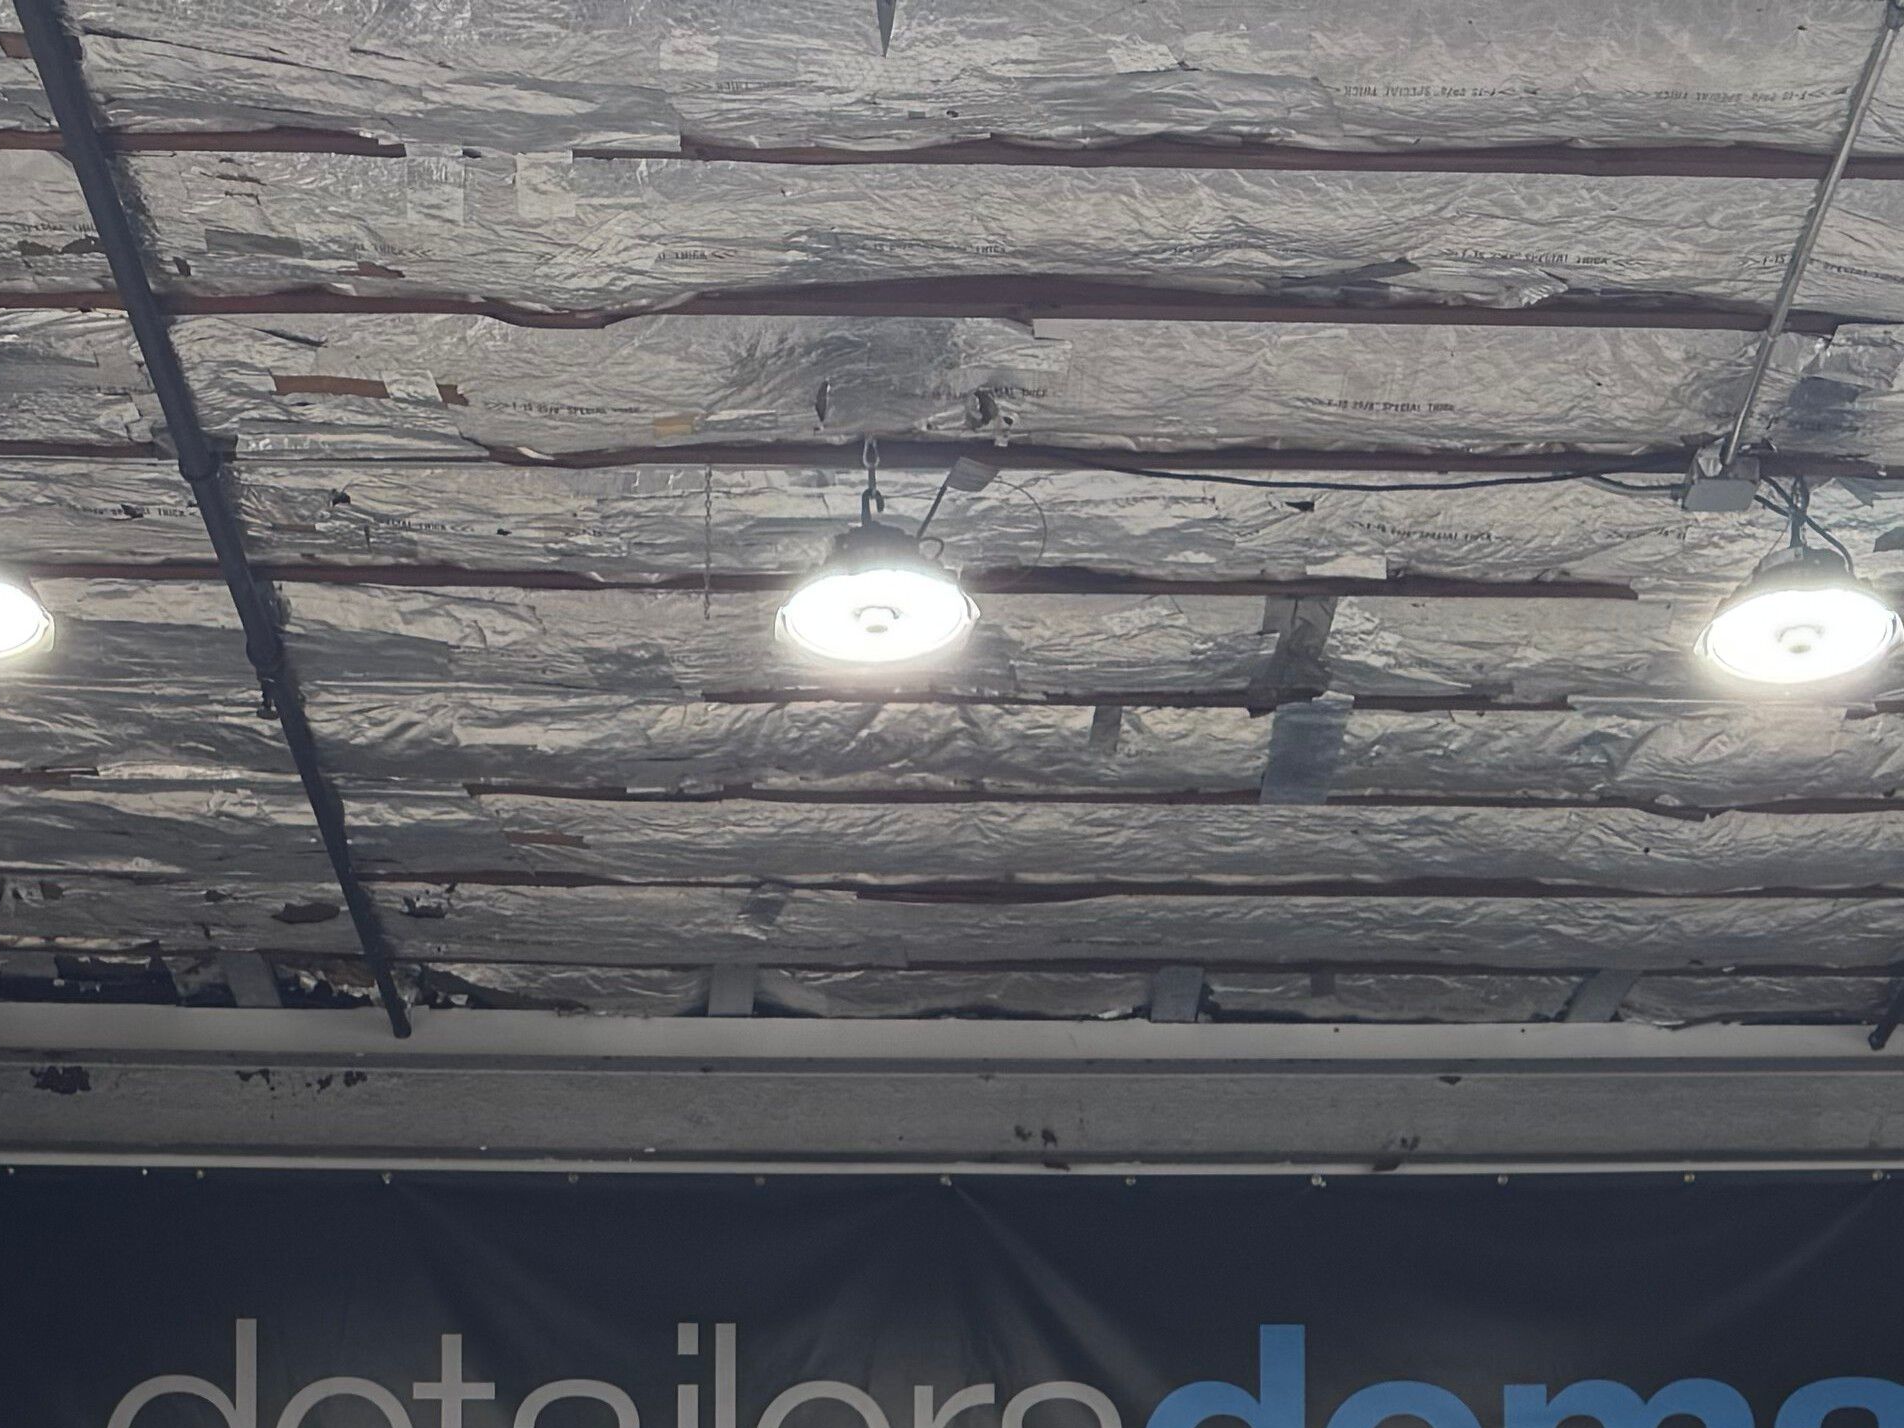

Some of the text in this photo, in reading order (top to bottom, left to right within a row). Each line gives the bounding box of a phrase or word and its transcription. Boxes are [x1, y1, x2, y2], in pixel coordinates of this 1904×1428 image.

[1343, 86, 1377, 97] THICK
[1385, 86, 1432, 97] SPECIAL
[1383, 401, 1422, 413] SPECIAL
